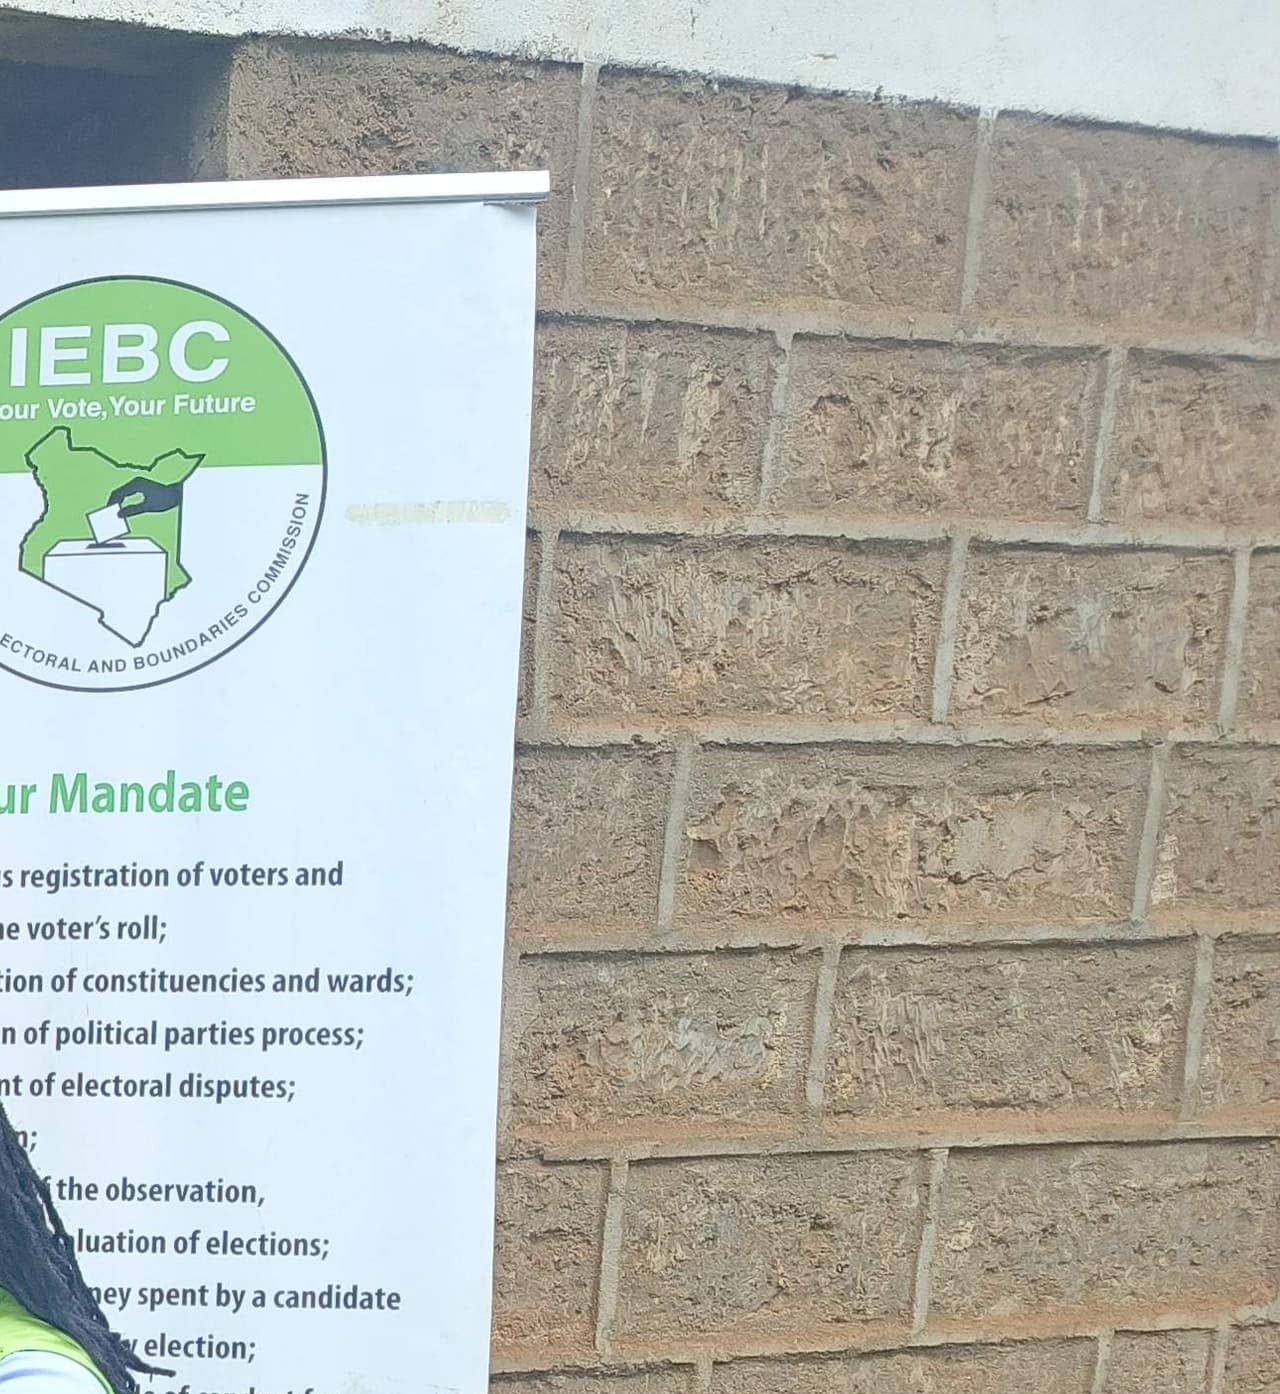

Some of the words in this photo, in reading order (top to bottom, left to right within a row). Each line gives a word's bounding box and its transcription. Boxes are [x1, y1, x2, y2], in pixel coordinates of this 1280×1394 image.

[9, 320, 231, 388] IEBC
[109, 395, 167, 418] Your
[173, 393, 257, 416] Future
[87, 658, 128, 674] AND
[133, 603, 249, 671] BOUNDARIES
[246, 492, 311, 605] COMMISSION
[48, 770, 251, 814] Mandate
[19, 861, 170, 895] registration
[176, 860, 206, 888] of
[209, 861, 289, 888] voters
[294, 859, 344, 887] and
[116, 913, 168, 945] roll;
[50, 966, 79, 994] of
[82, 966, 266, 994] constituencies
[271, 966, 321, 994] and
[326, 966, 415, 998] wards;
[23, 1019, 53, 1046] of
[55, 1019, 158, 1052] political
[164, 1019, 256, 1053] parties
[261, 1026, 365, 1053] process;
[28, 1071, 58, 1098] of
[60, 1071, 173, 1098] electoral
[178, 1072, 297, 1105] disputes;
[55, 1174, 100, 1201] the
[105, 1176, 266, 1208] observation,
[77, 1227, 167, 1256] luation
[173, 1228, 202, 1255] of
[205, 1229, 330, 1261] elections;
[137, 1282, 210, 1313] spent
[215, 1281, 248, 1313] by
[251, 1289, 267, 1309] a
[273, 1282, 402, 1311] candidate
[143, 1331, 256, 1364] election;
